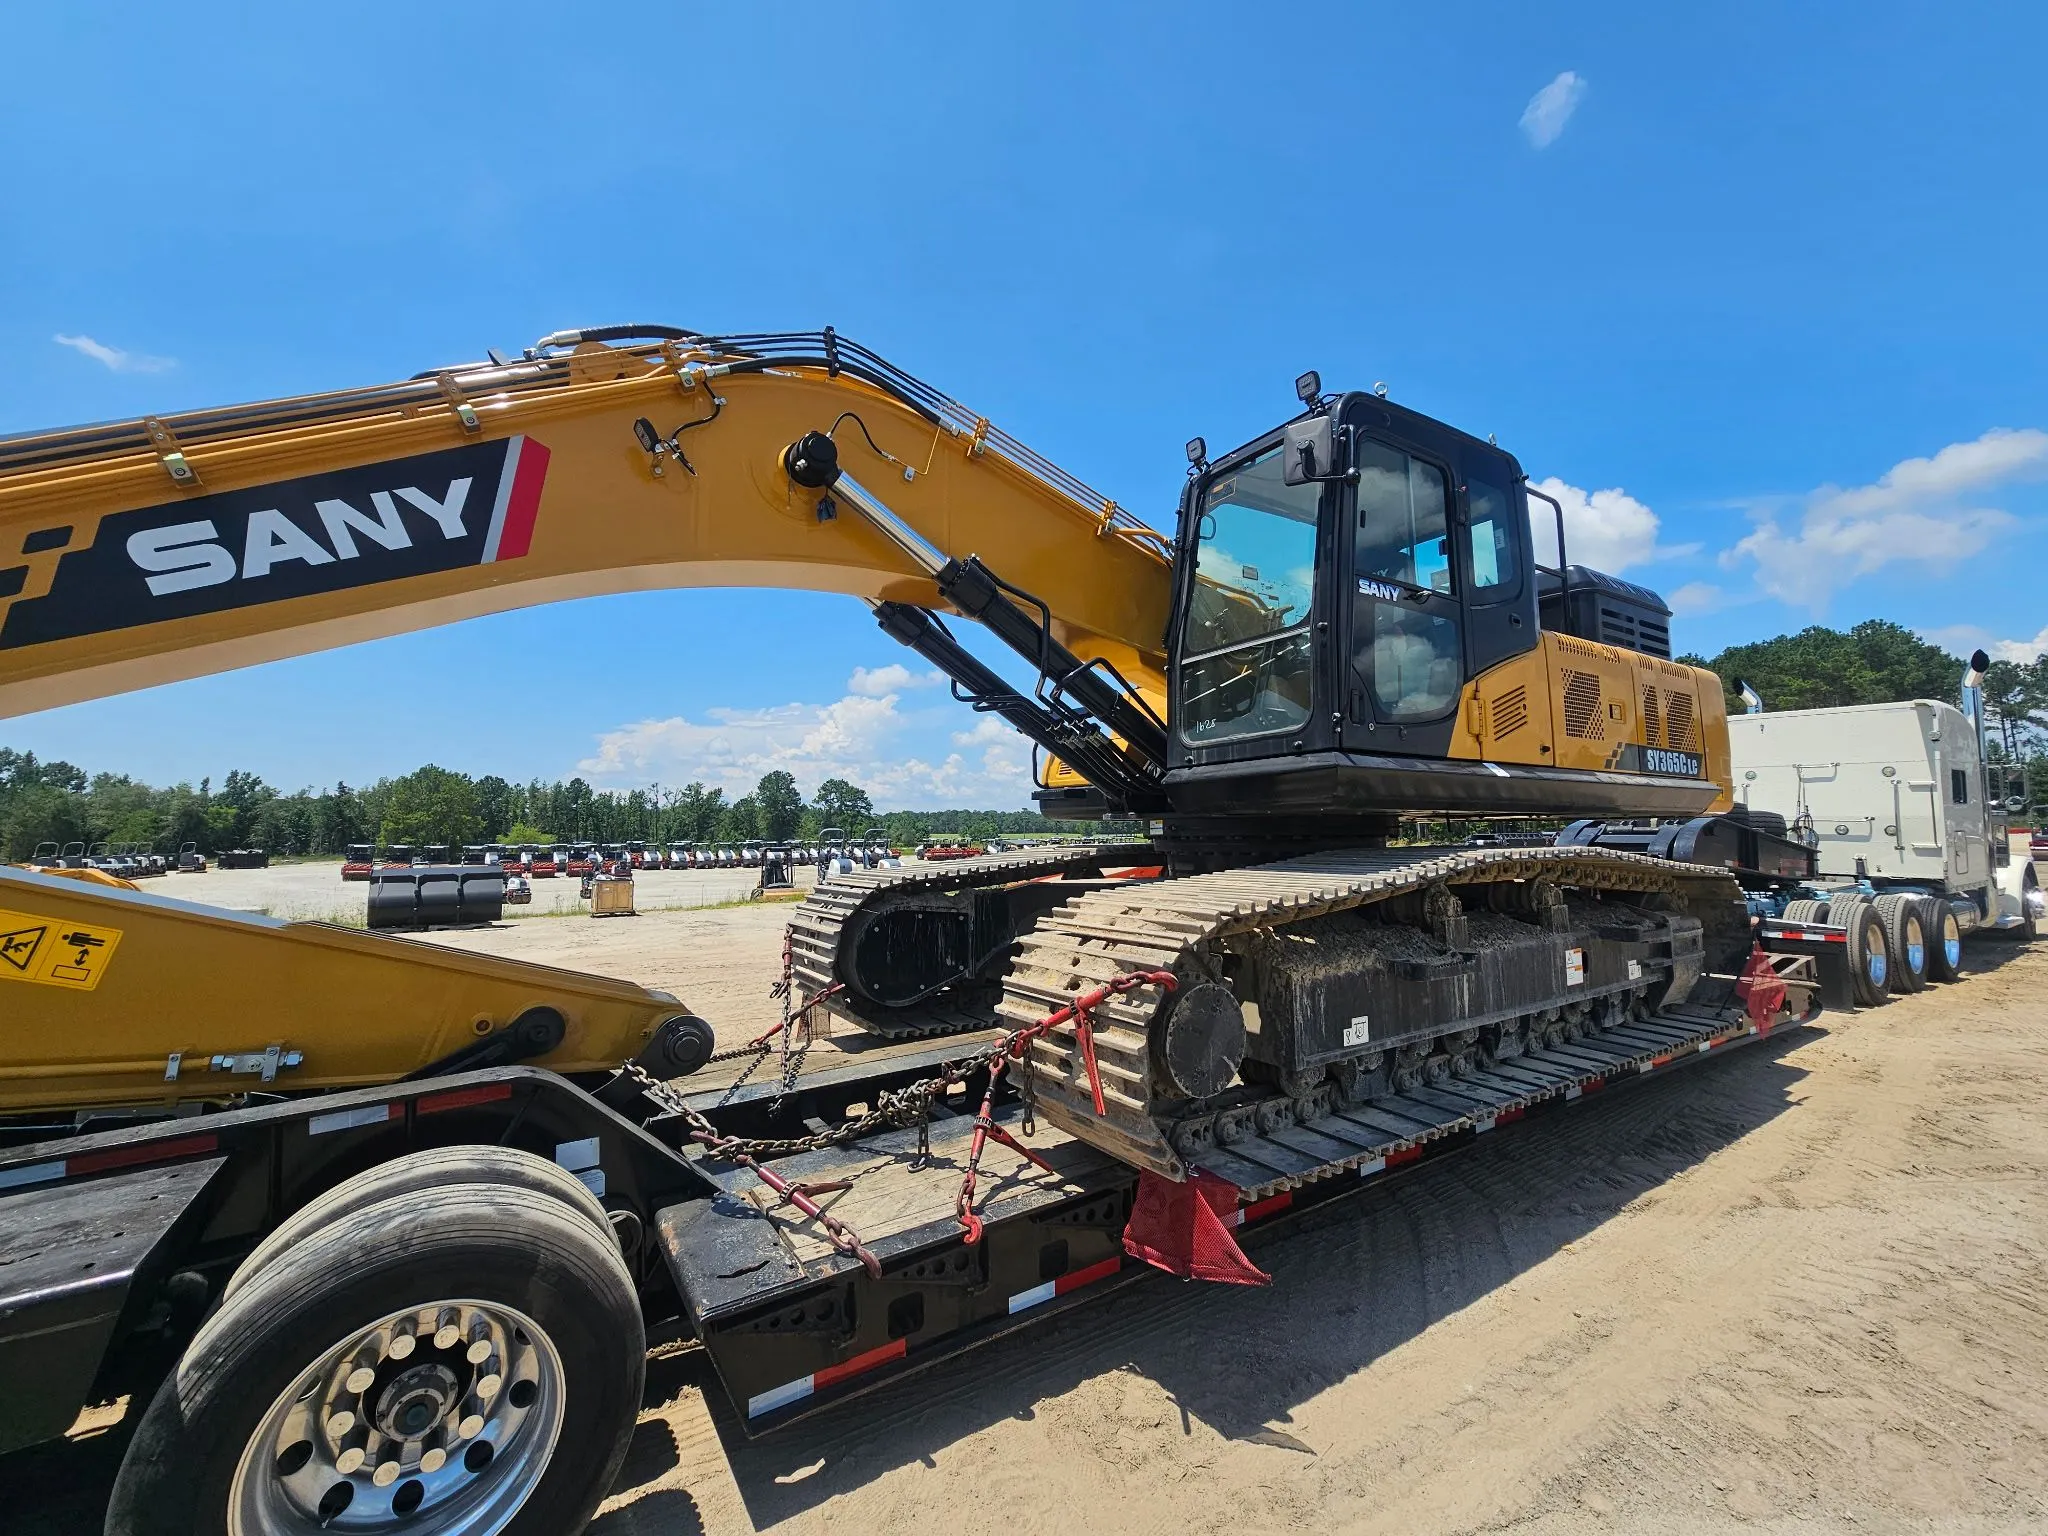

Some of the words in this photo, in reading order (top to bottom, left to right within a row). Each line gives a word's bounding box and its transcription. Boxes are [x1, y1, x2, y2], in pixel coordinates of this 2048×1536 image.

[126, 476, 473, 597] SANY
[1358, 578, 1400, 602] SANY
[1647, 749, 1687, 774] SY365C
